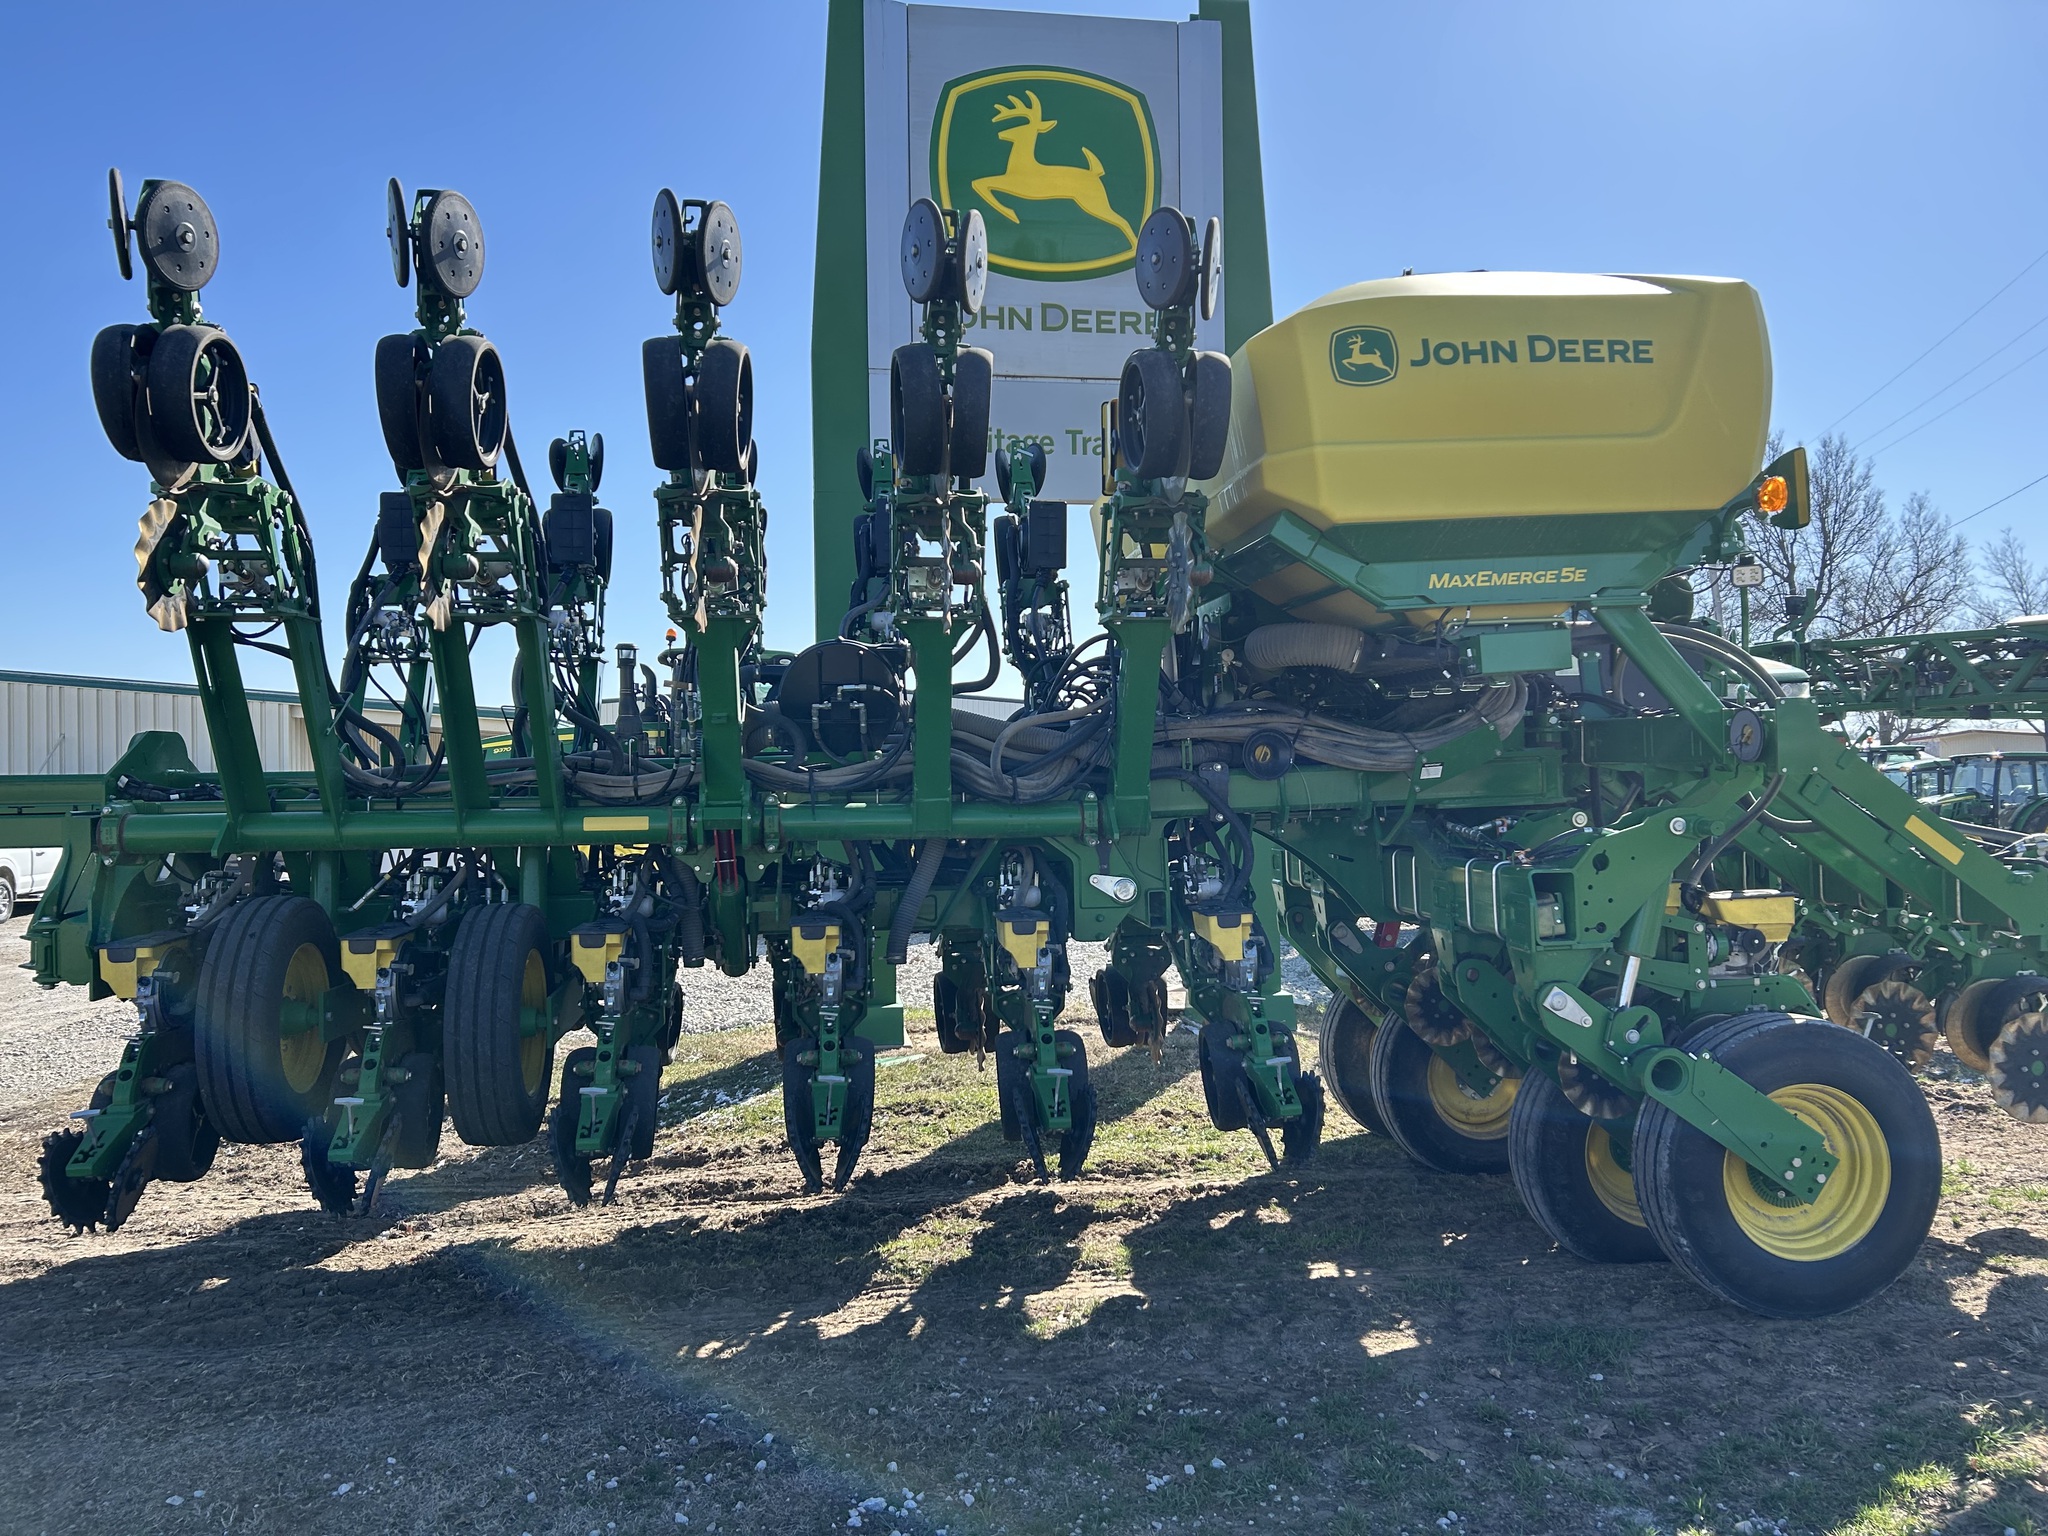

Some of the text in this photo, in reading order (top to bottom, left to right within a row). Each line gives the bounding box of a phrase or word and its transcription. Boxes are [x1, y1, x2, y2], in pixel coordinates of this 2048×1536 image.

[963, 305, 1032, 331] HN
[1410, 334, 1654, 367] JOHN DEERE
[1065, 429, 1102, 456] Tra
[1560, 567, 1588, 583] 5E
